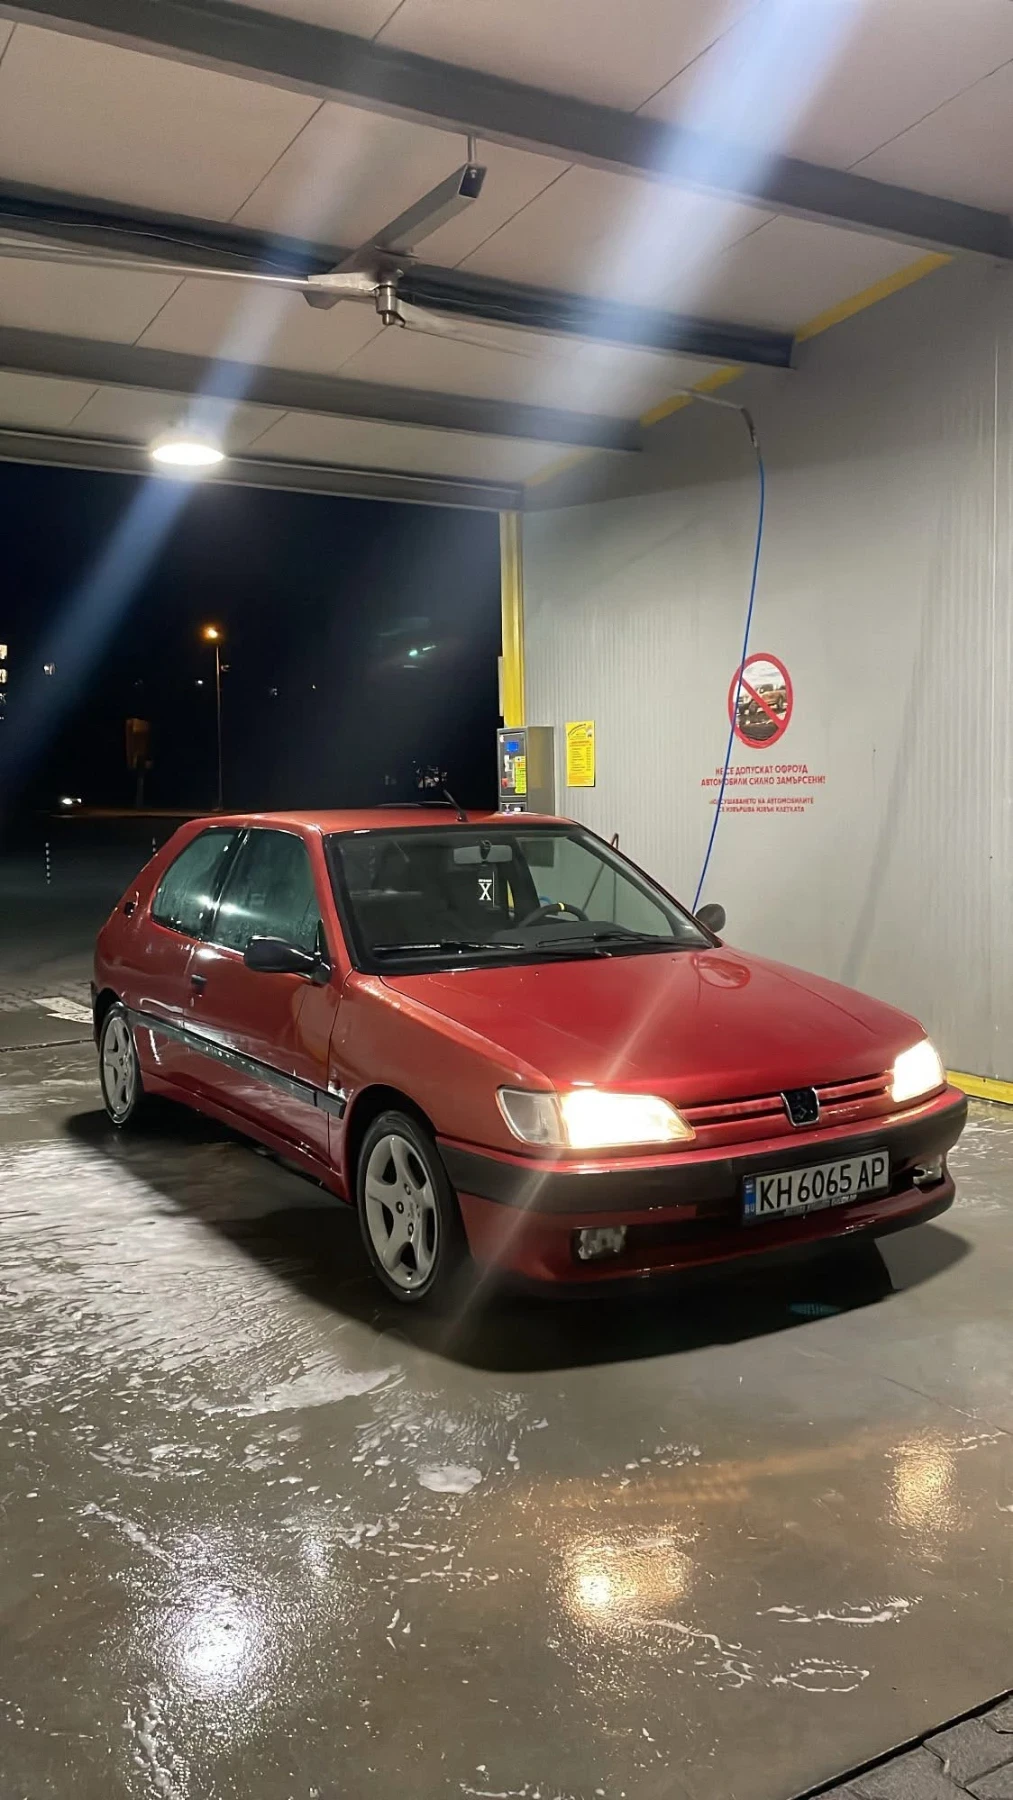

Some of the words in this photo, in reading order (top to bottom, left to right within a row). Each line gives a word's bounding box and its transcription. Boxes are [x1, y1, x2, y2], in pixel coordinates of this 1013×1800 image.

[735, 765, 773, 776] ДОПУСКАТ
[774, 764, 808, 774] ОФРОУД
[749, 776, 774, 786] СИЛНО
[776, 775, 826, 785] ЗАМЪРСЕНИ!
